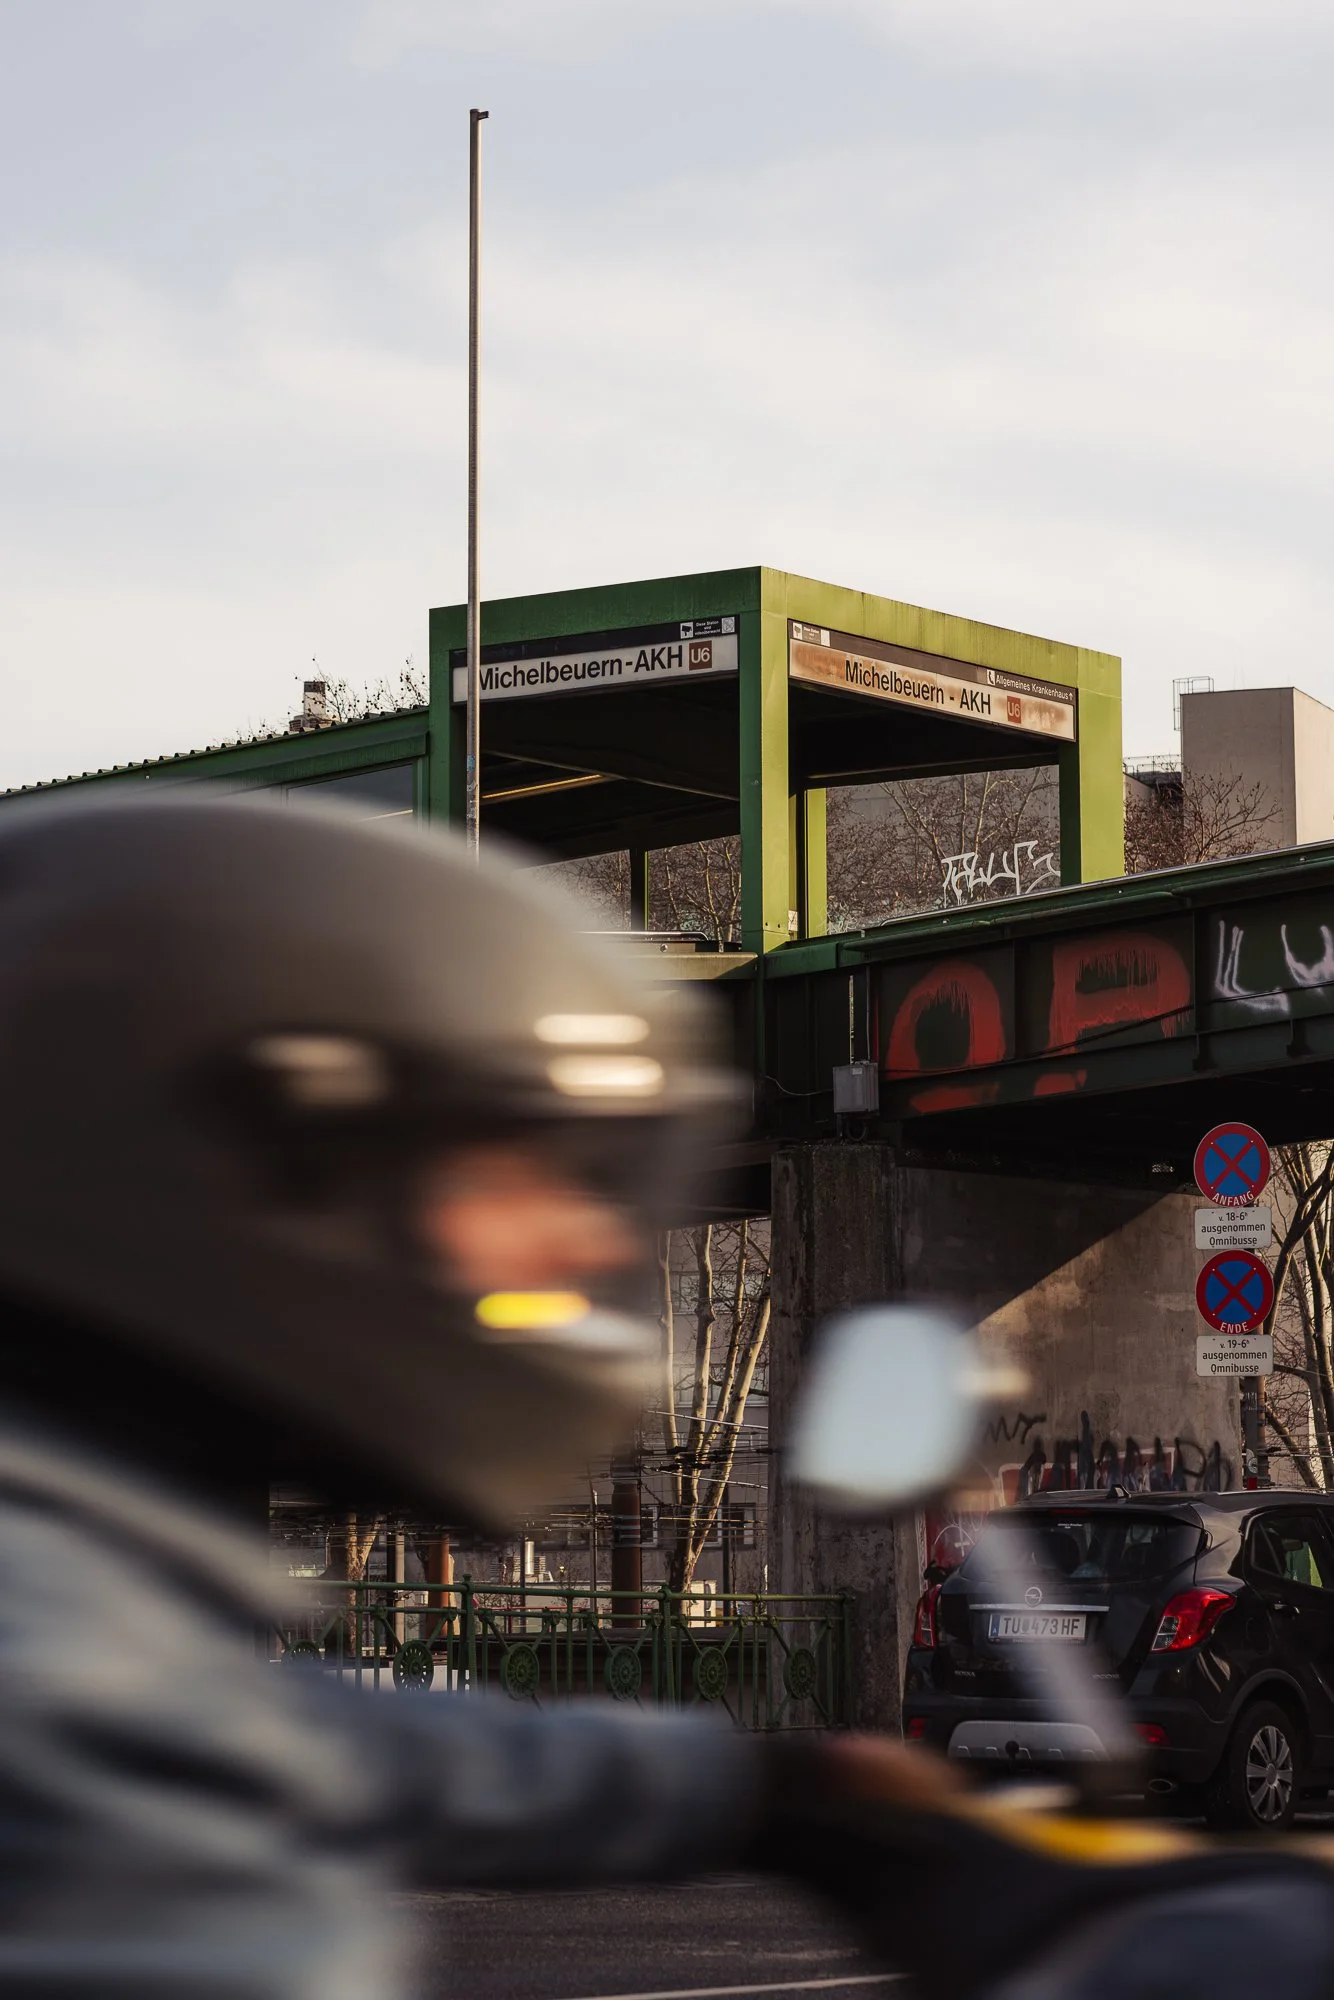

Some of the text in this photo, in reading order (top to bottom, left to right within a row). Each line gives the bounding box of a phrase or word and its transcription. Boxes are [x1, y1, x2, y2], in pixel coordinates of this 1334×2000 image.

[690, 647, 711, 664] U6
[845, 659, 945, 705] Michelbeuern
[959, 687, 991, 715] AKH
[1007, 701, 1021, 717] U6
[995, 674, 1069, 700] Allgemeines Krankenhaus
[1211, 1190, 1255, 1207] ANFANG
[1201, 1223, 1266, 1235] ausgenommen
[1209, 1236, 1258, 1246] Omnibusse
[1219, 1321, 1250, 1334] ENDE
[1202, 1351, 1268, 1362] ausgenommen
[1210, 1363, 1260, 1373] Omnibusse
[1003, 1616, 1020, 1635] TU
